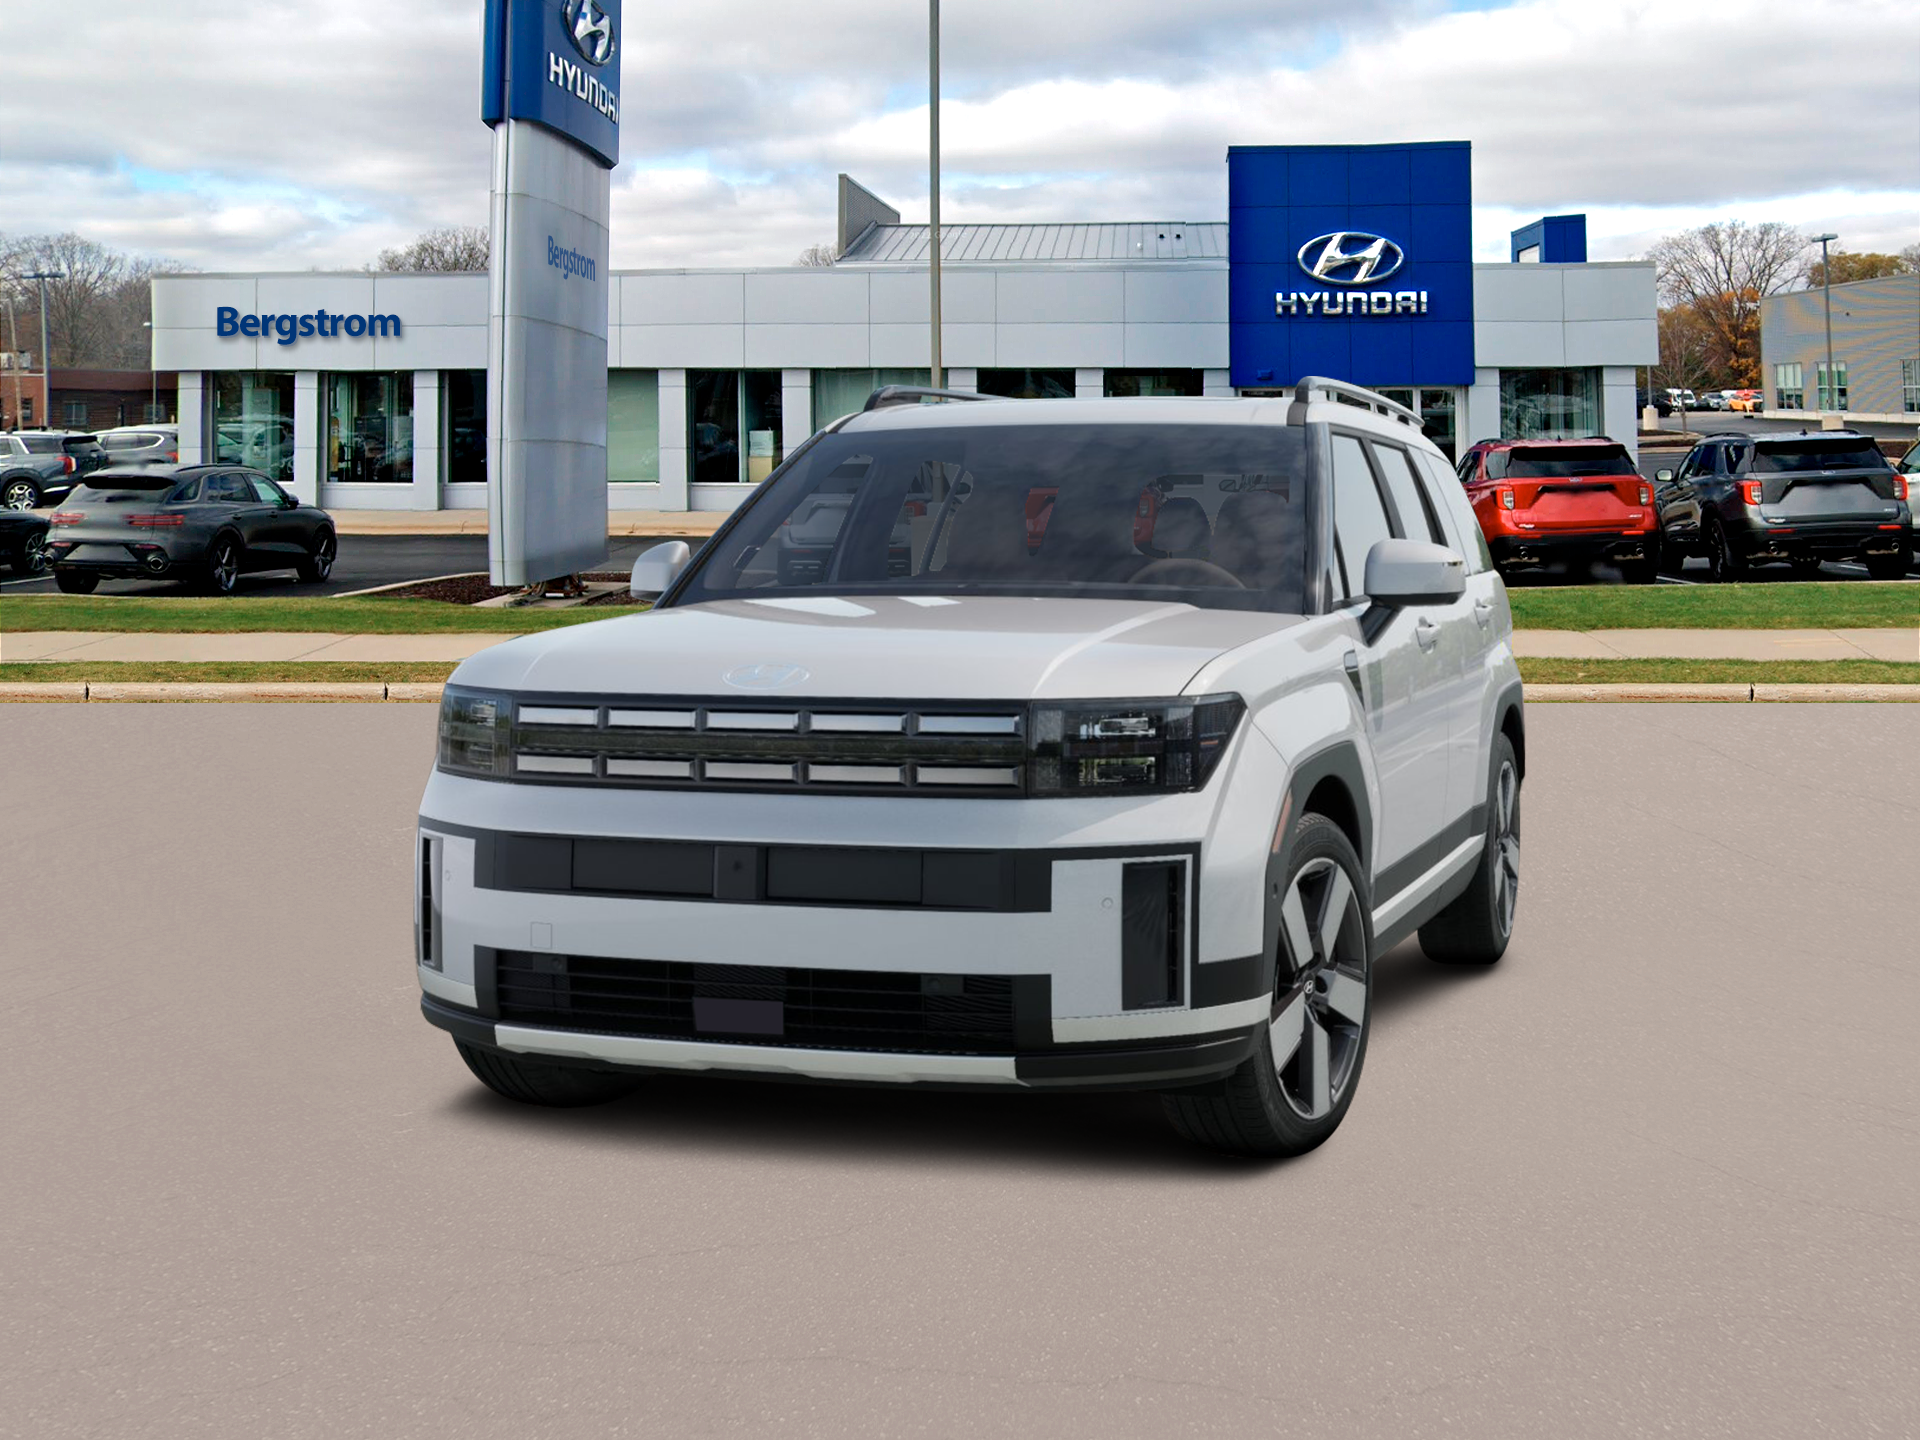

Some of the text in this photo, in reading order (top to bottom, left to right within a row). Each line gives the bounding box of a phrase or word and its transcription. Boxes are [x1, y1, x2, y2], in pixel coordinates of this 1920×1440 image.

[549, 51, 619, 124] HYUNDAI
[548, 235, 596, 282] Bergstrom
[1276, 291, 1428, 315] HYUNDAI
[217, 306, 401, 346] Bergstrom
